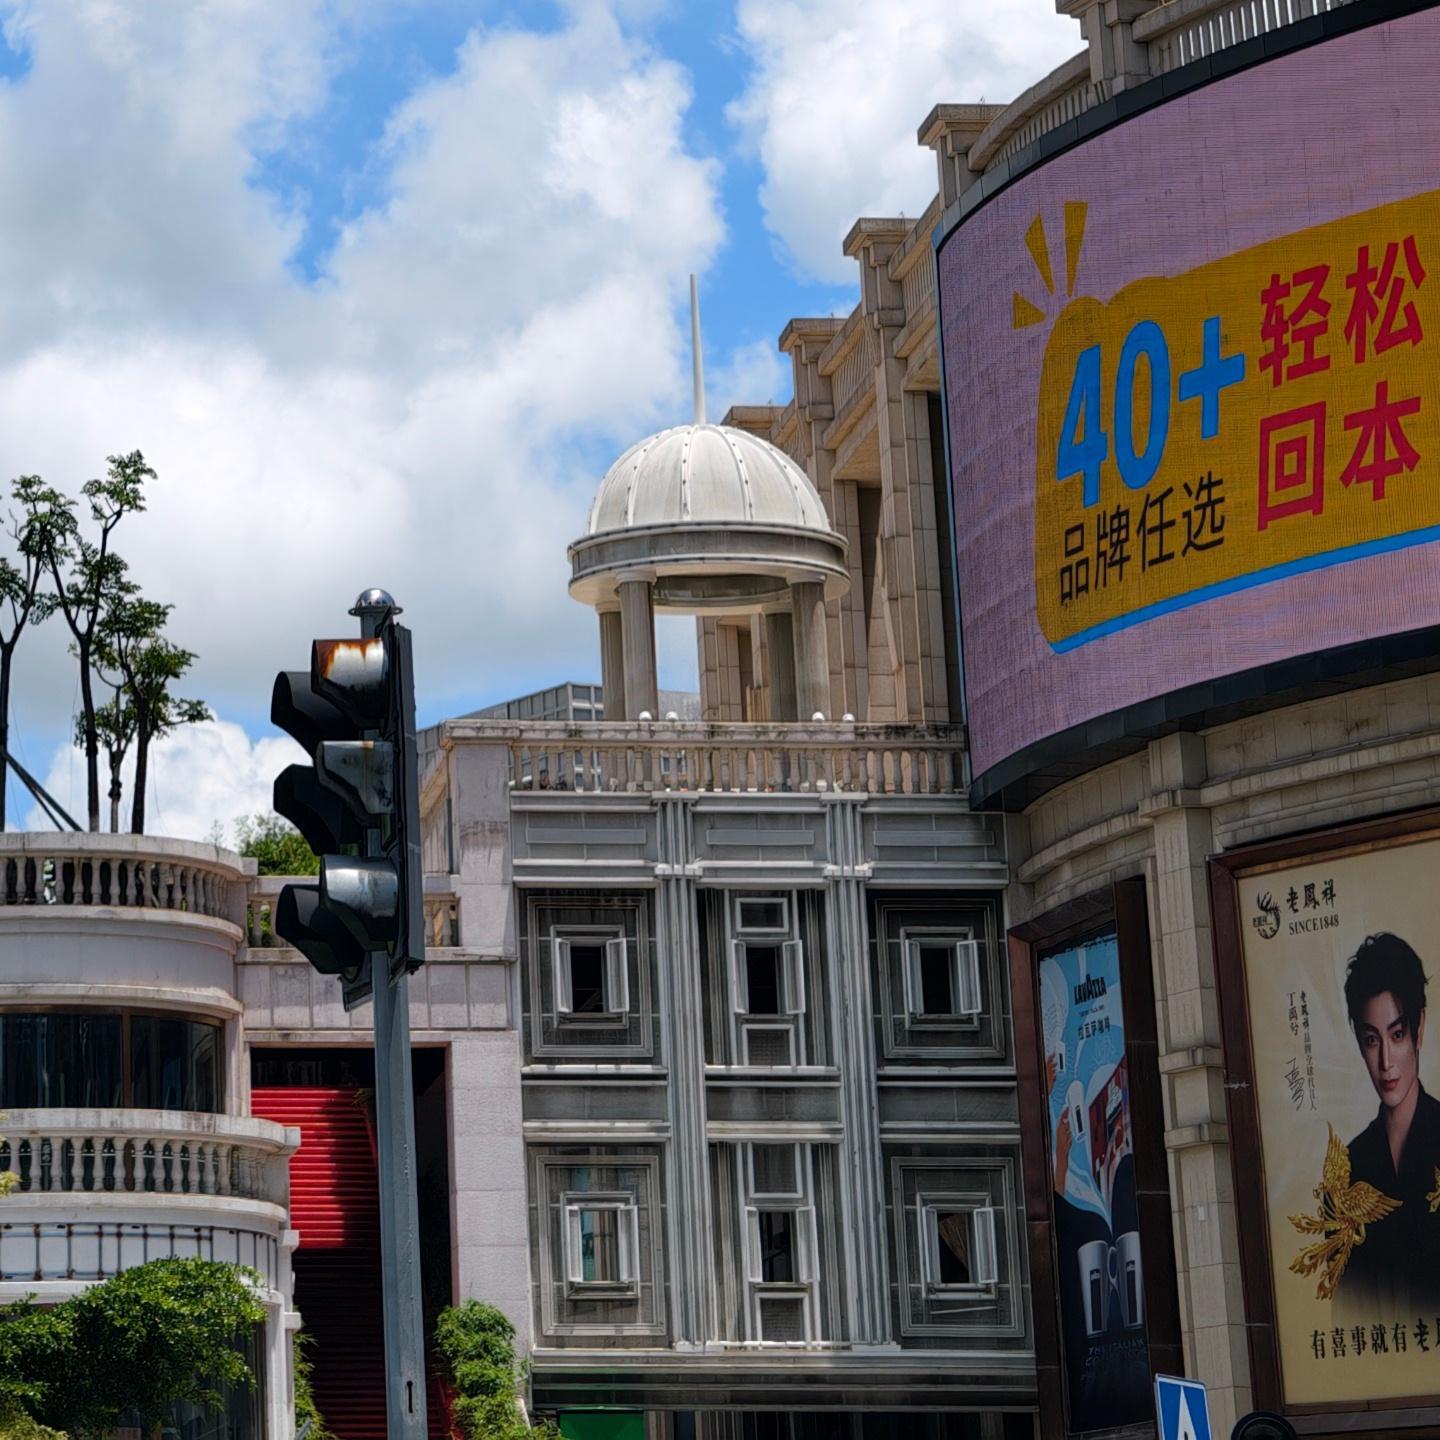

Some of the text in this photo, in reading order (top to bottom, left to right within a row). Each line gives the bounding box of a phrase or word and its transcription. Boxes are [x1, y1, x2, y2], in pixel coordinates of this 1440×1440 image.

[1258, 234, 1427, 388] 轻松
[1056, 315, 1246, 510] 40+
[1257, 380, 1422, 532] 回本
[1059, 470, 1227, 607] 品牌任选
